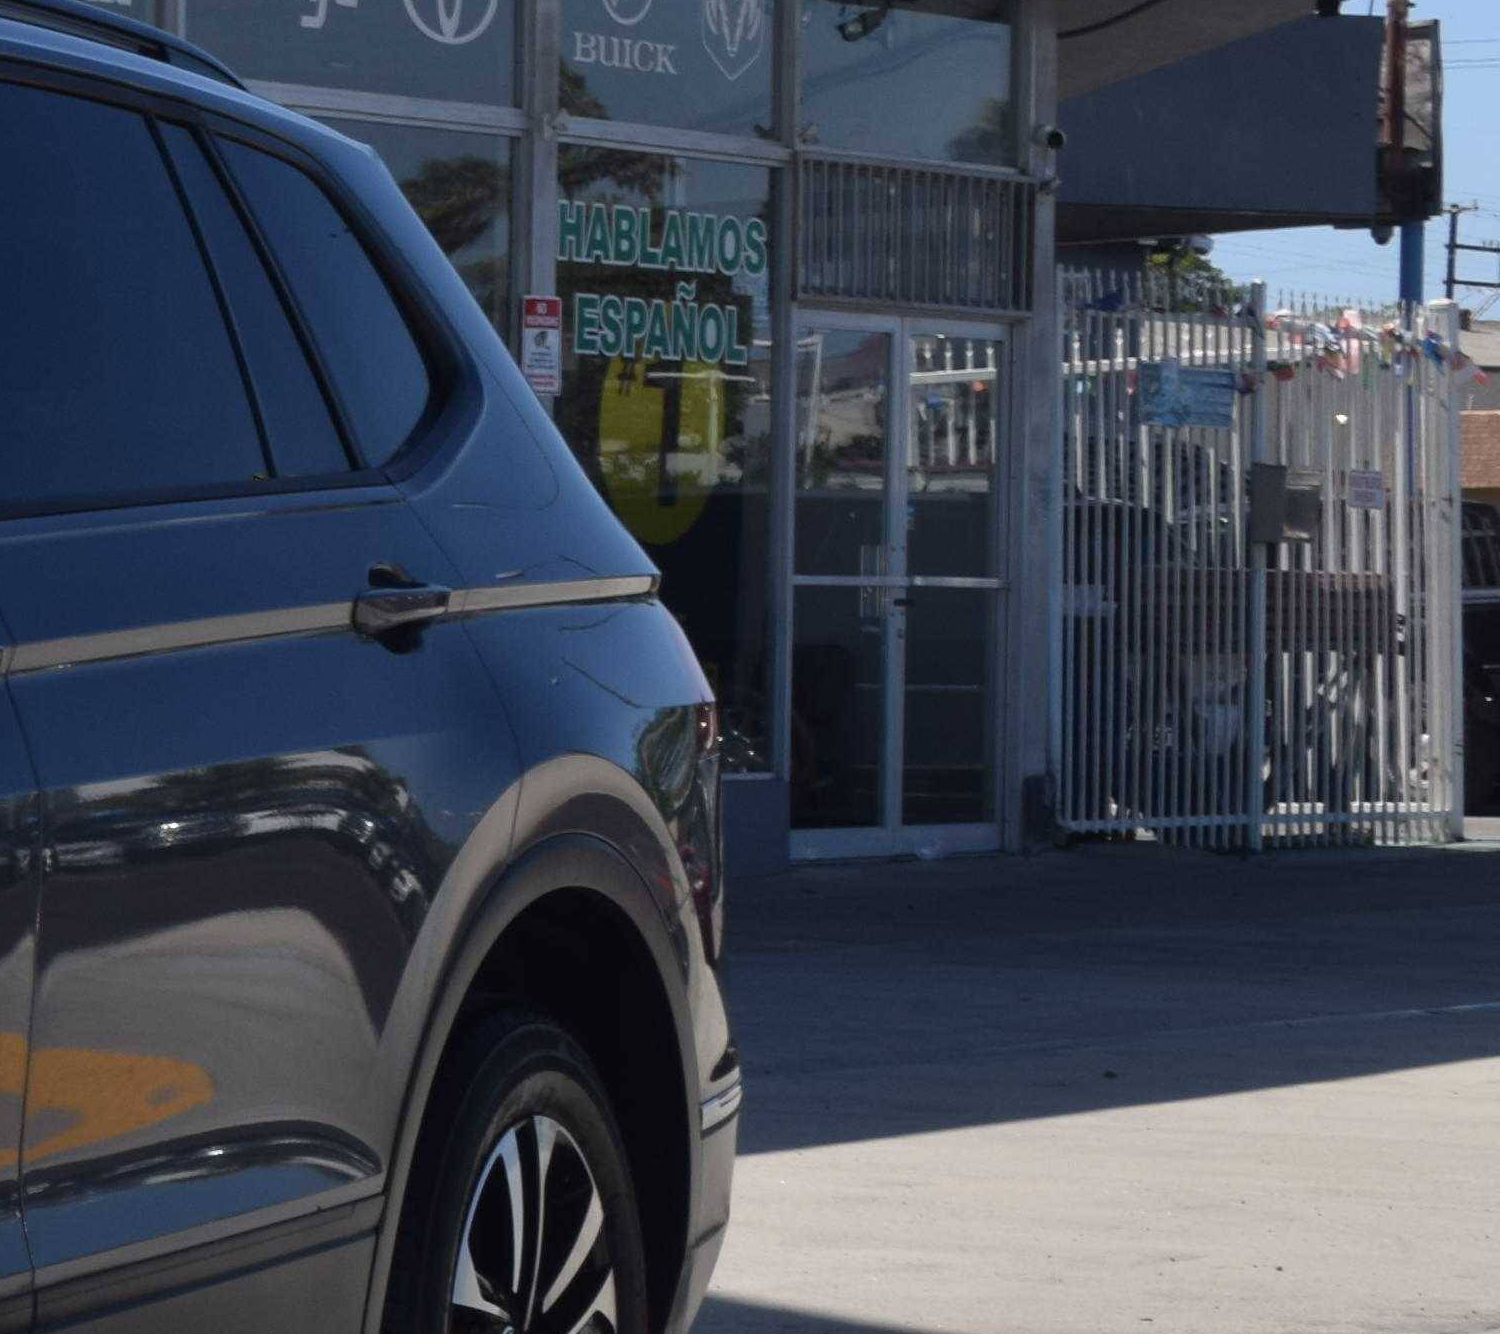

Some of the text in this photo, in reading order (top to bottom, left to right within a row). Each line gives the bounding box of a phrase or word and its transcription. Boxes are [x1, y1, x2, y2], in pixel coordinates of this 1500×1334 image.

[573, 30, 678, 75] BUICK
[557, 199, 767, 275] HABLAMOS
[574, 279, 748, 365] ESPAÑOL
